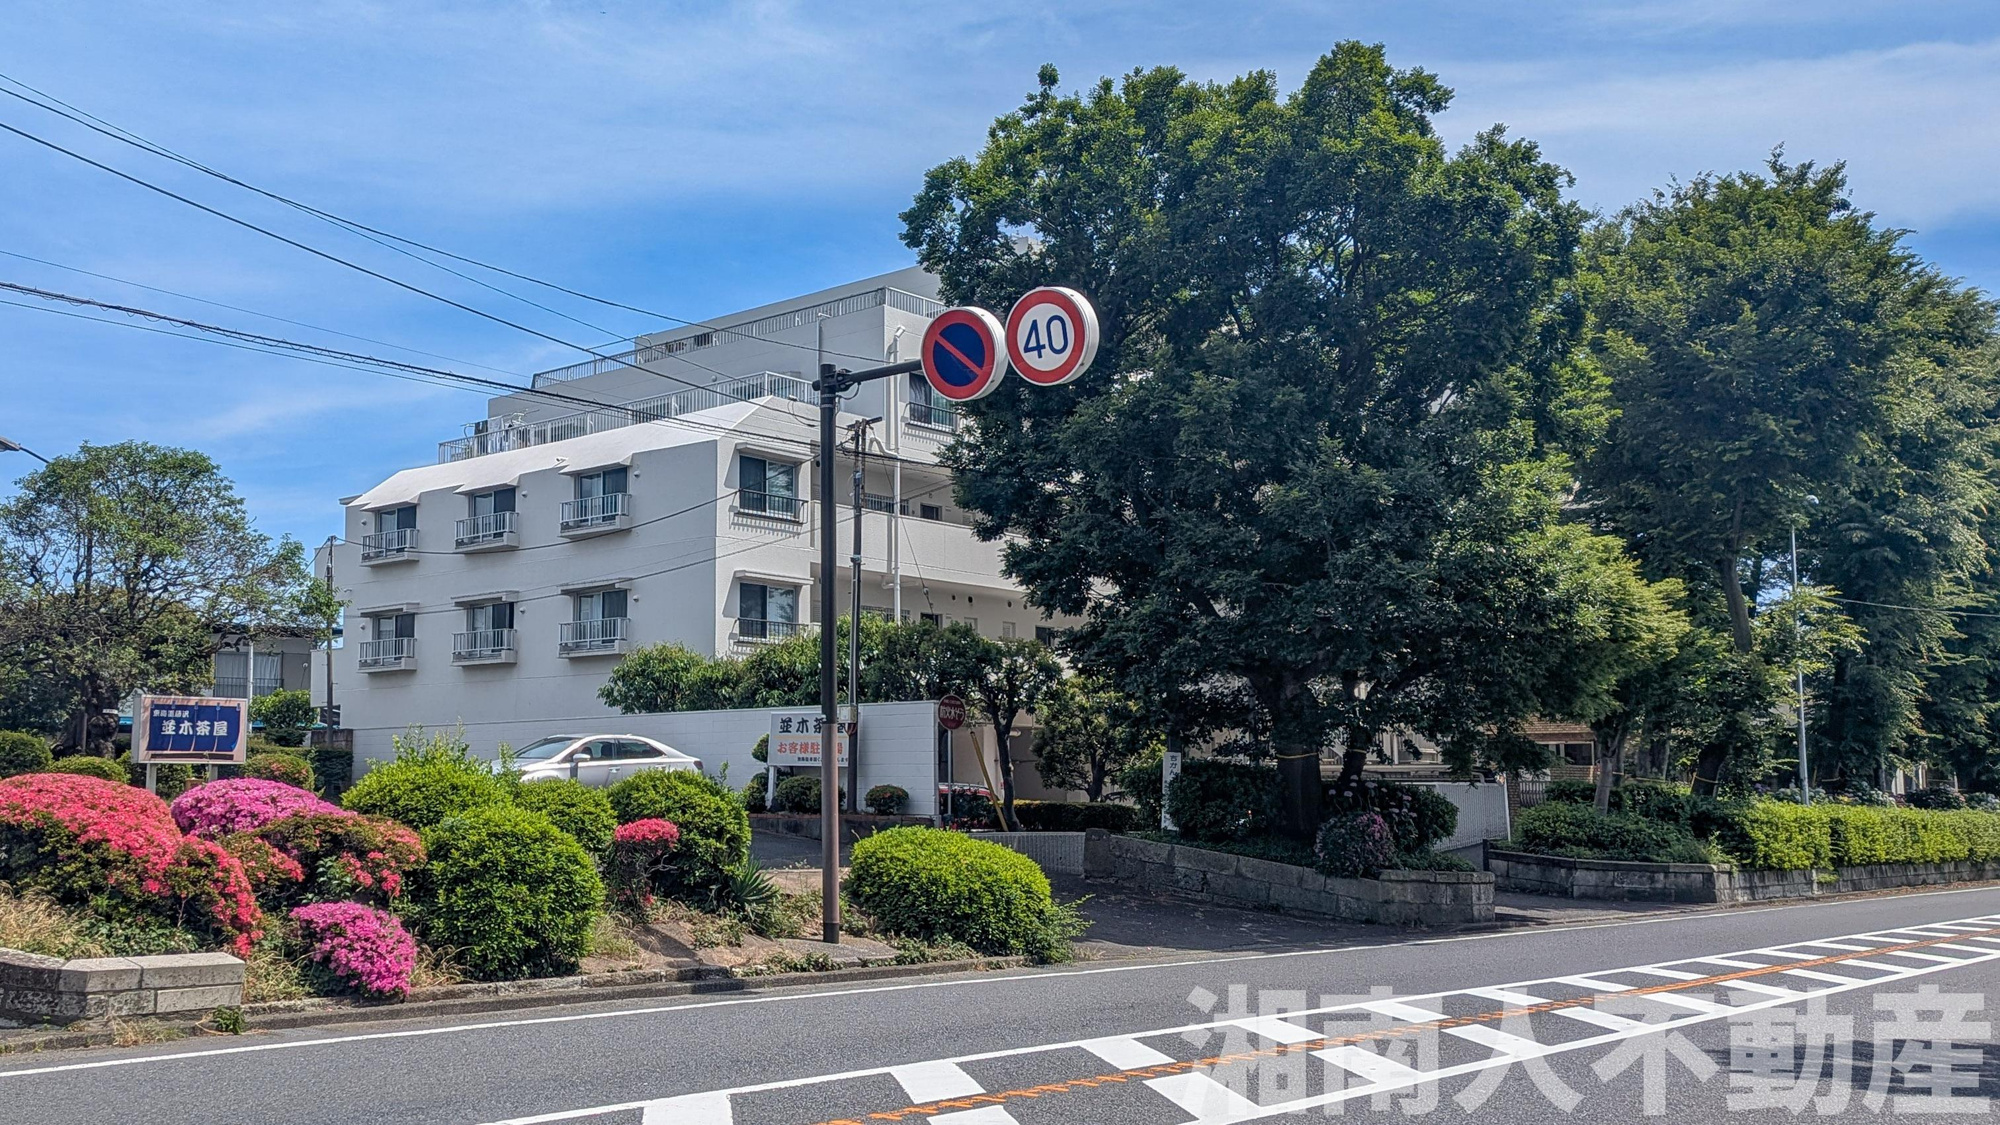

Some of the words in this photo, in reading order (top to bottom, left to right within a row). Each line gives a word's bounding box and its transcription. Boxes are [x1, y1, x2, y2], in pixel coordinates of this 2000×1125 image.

[1023, 314, 1069, 359] 40
[160, 719, 228, 736] 並木茶屋
